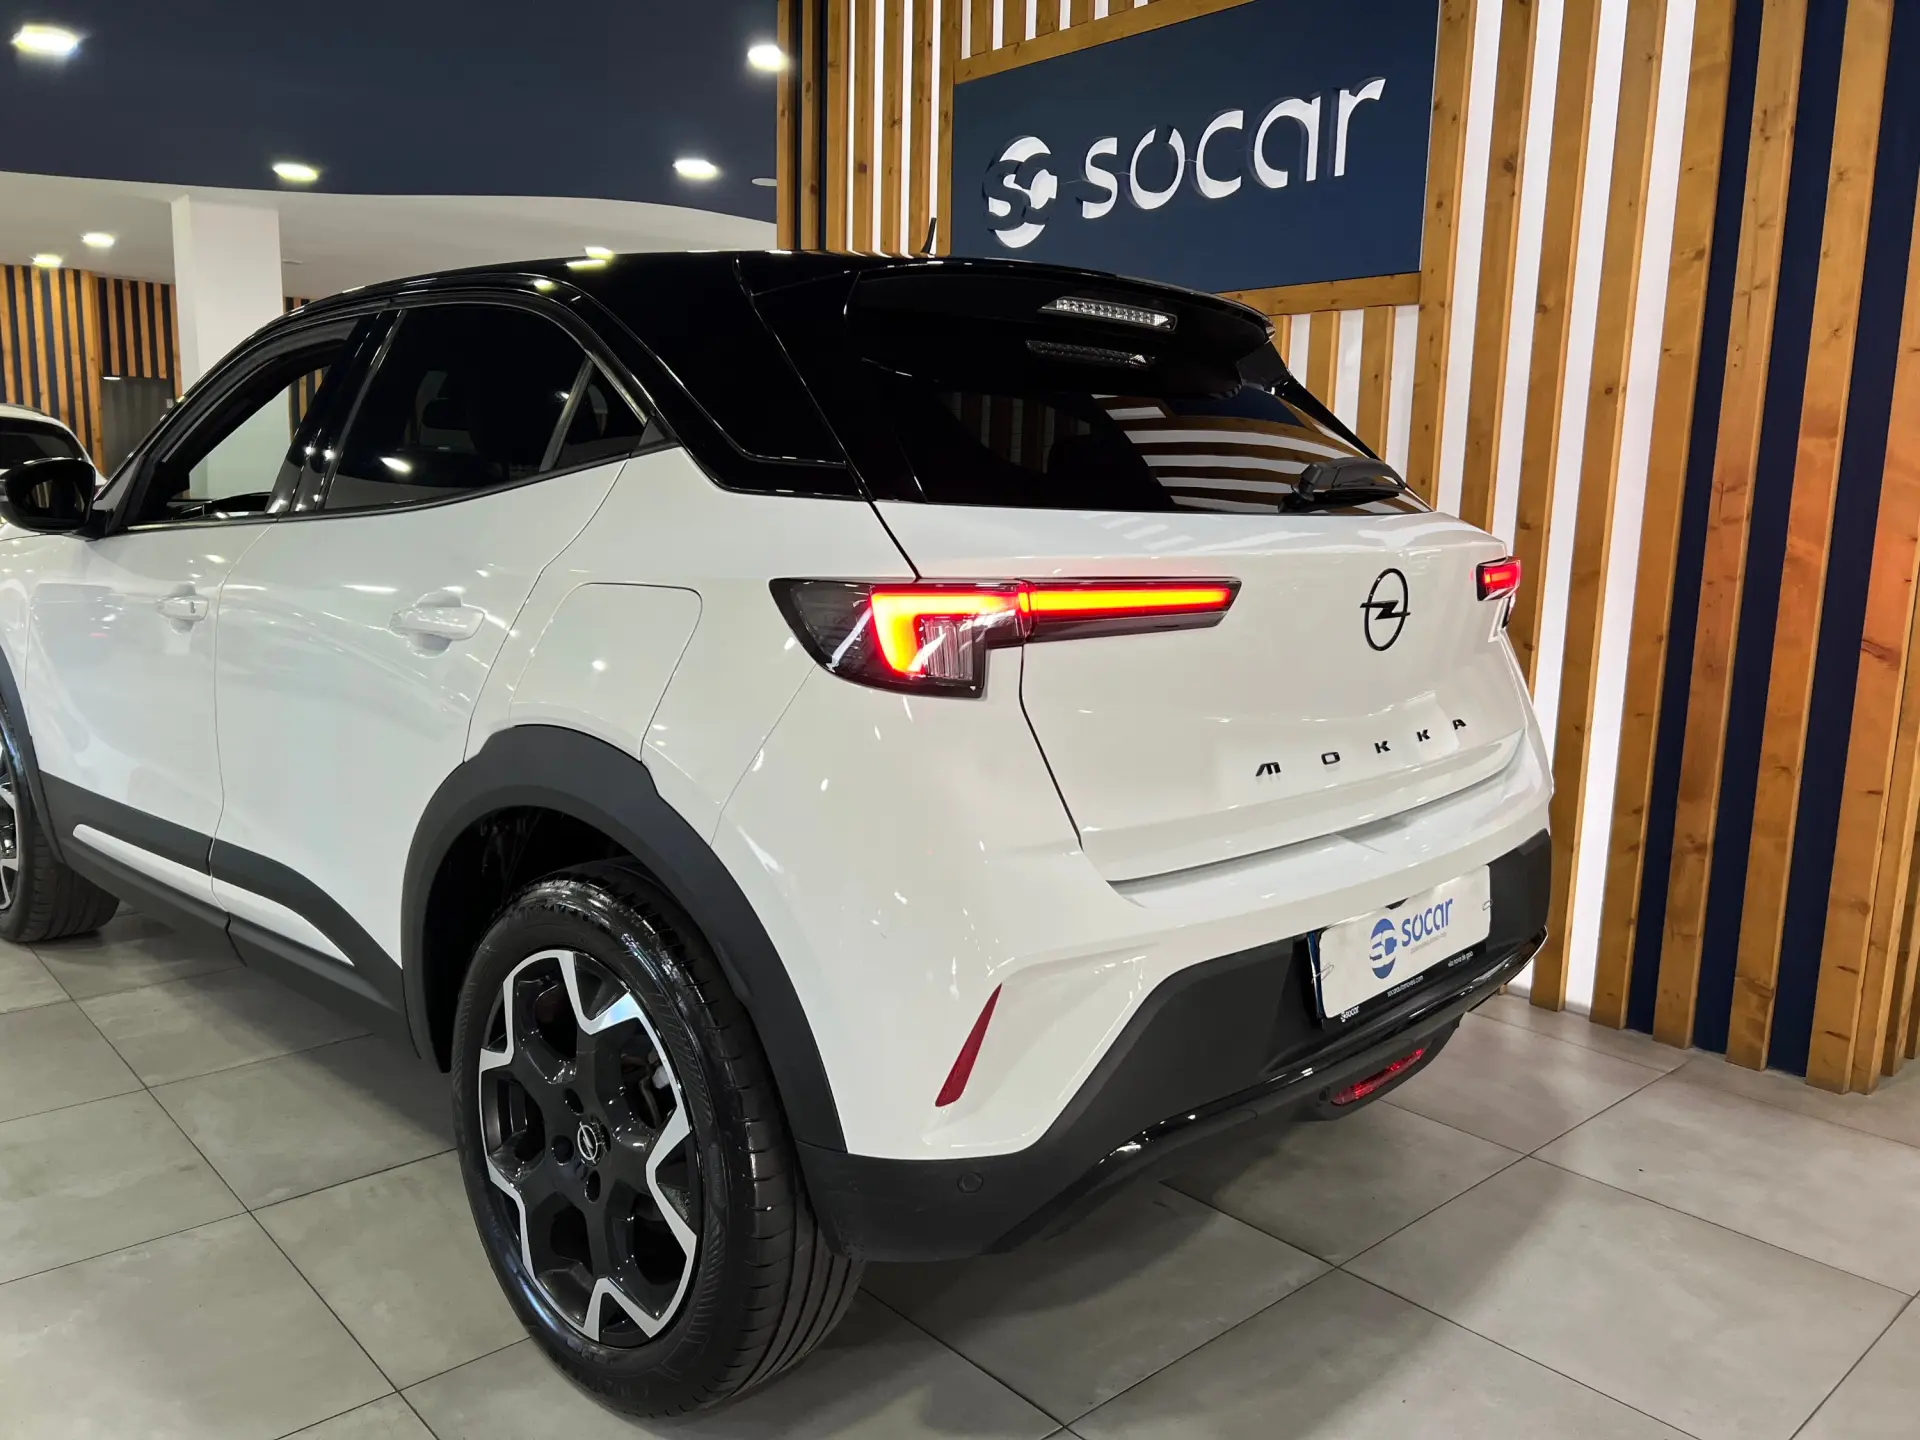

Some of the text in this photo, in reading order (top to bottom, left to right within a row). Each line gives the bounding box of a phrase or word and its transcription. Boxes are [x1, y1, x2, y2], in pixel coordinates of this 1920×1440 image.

[1077, 77, 1386, 219] socar
[1255, 718, 1467, 777] MOKKA
[1401, 898, 1453, 947] socar
